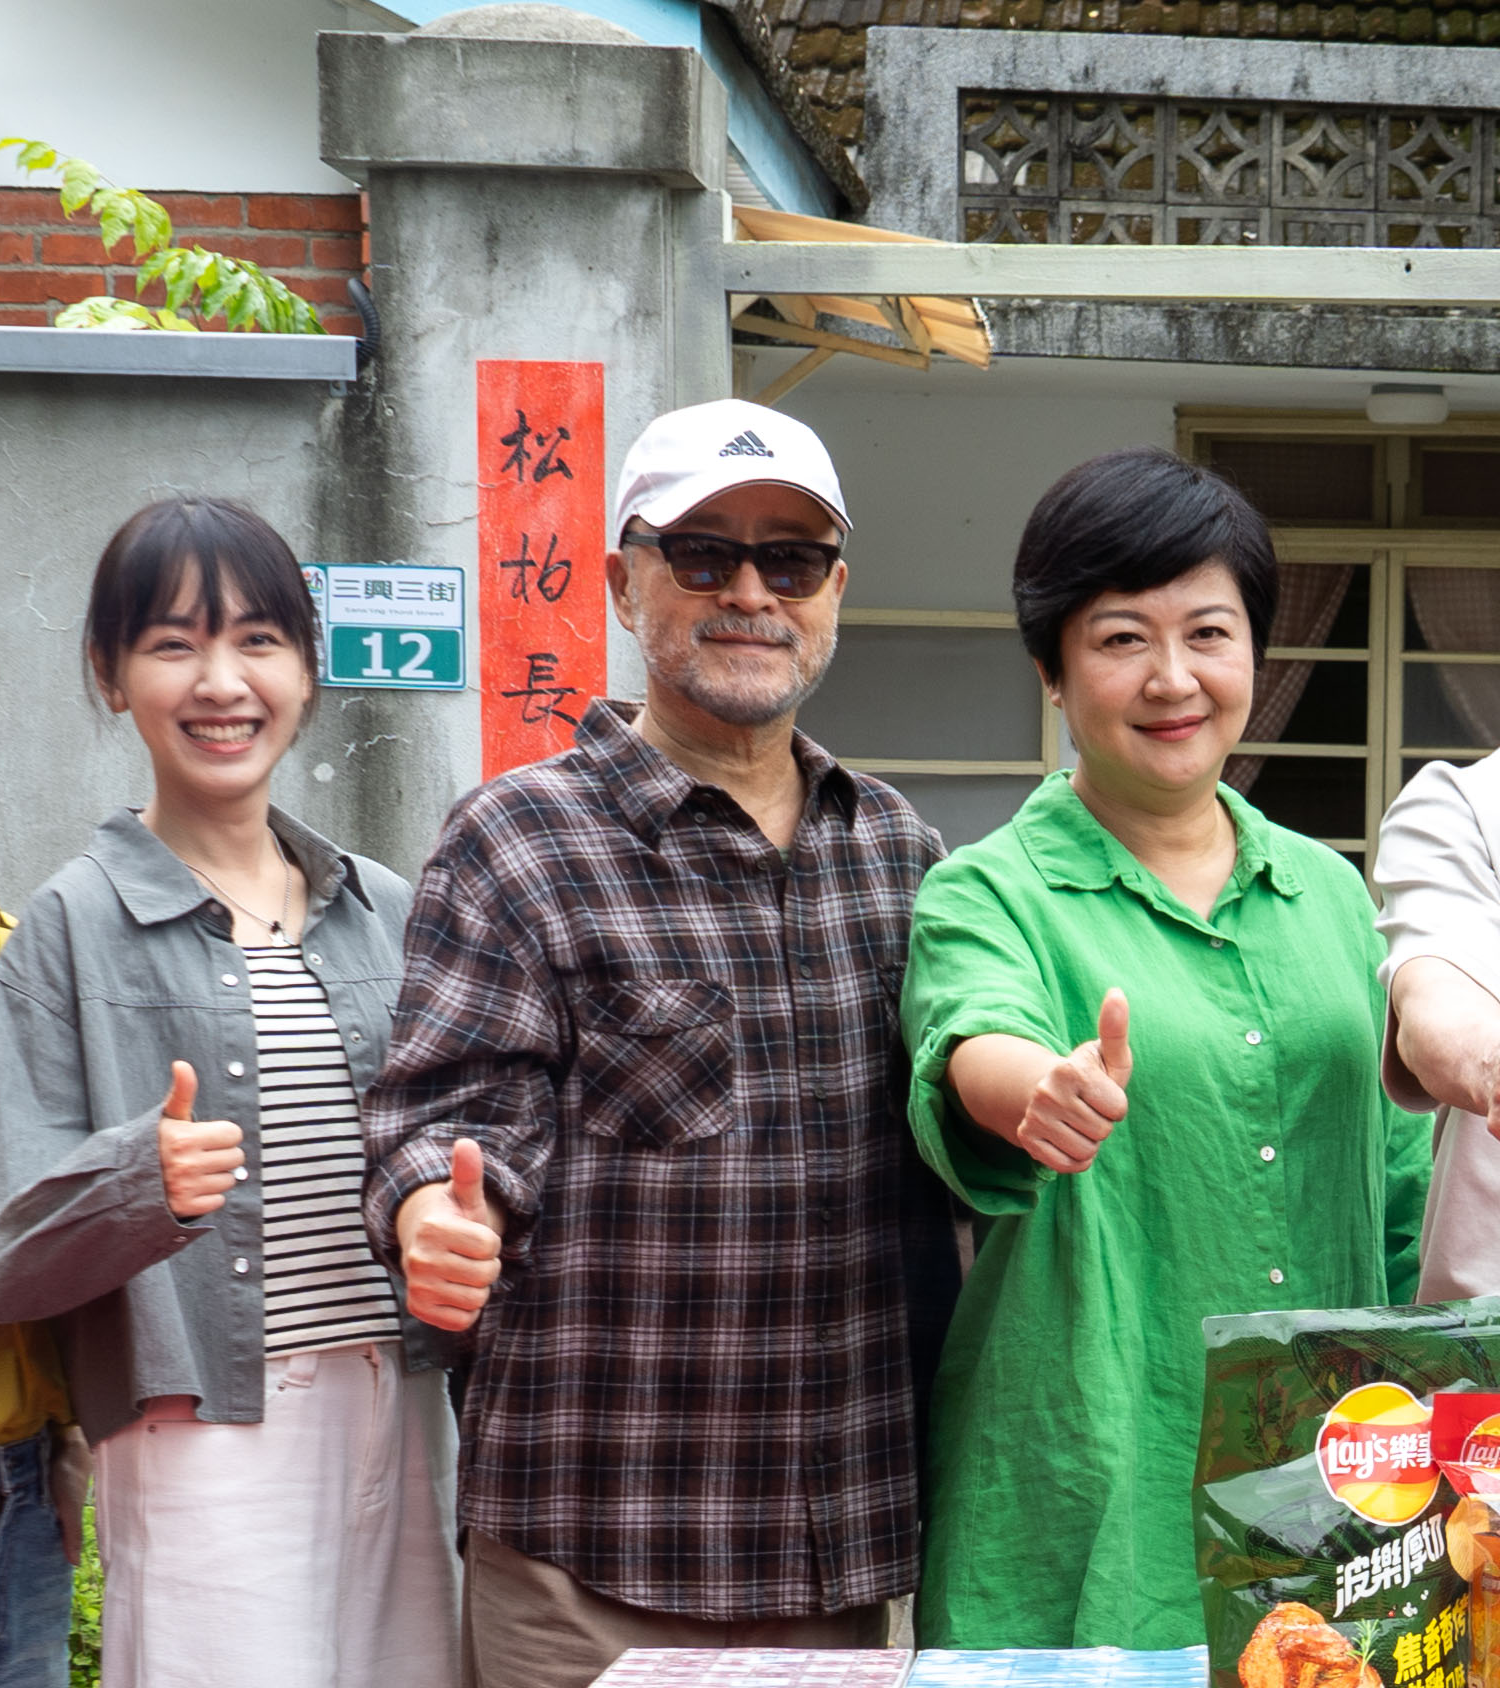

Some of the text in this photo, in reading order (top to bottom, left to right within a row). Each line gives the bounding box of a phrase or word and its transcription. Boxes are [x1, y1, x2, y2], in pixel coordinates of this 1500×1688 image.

[719, 444, 774, 458] adidas
[332, 579, 456, 602] 三興三街
[362, 632, 434, 679] 12
[1328, 1432, 1389, 1479] Lay's
[1333, 1513, 1445, 1618] 波樂厚切
